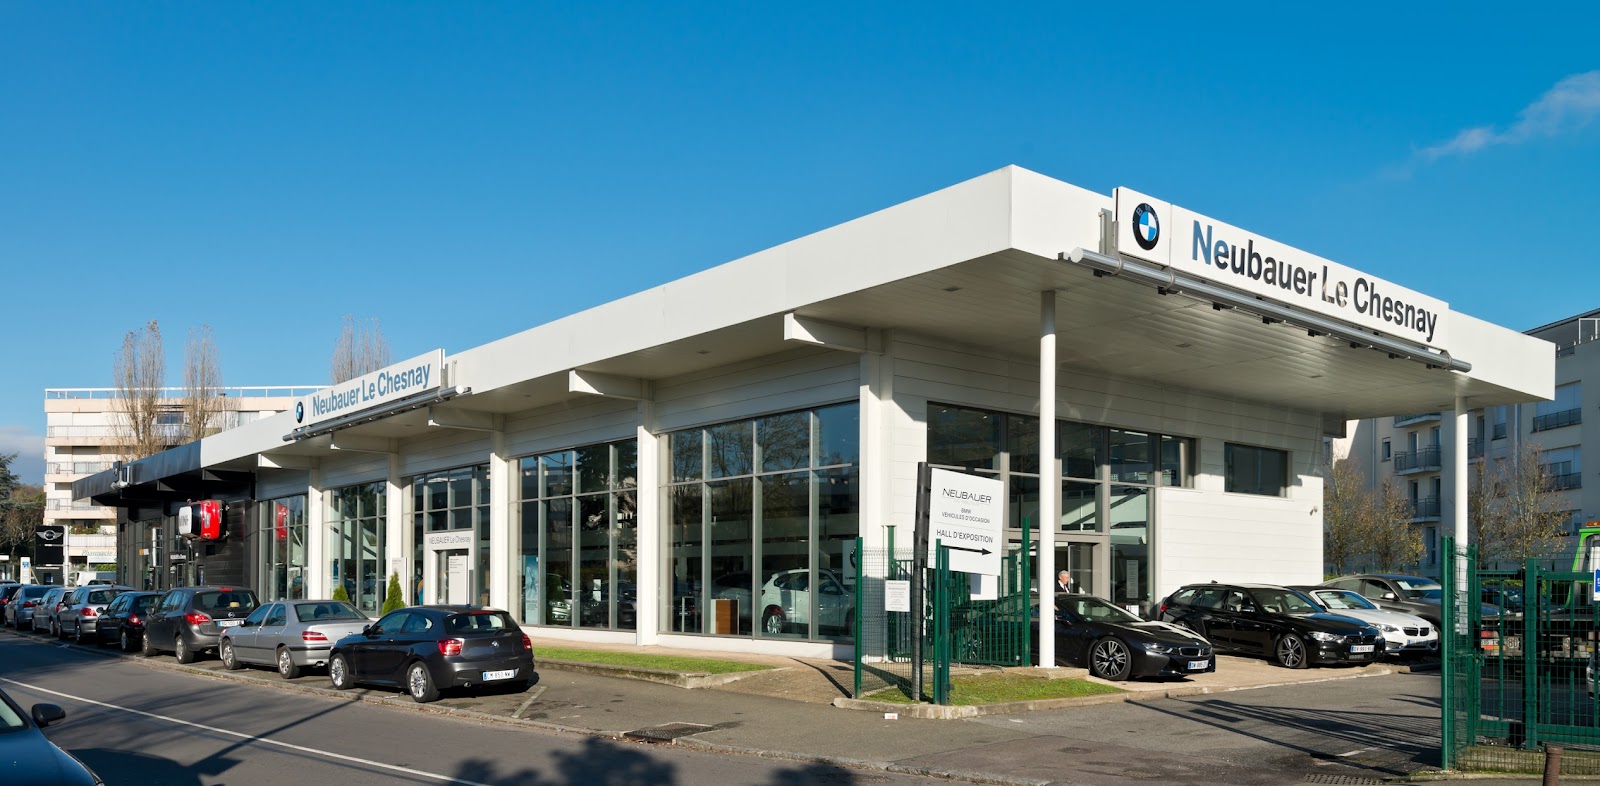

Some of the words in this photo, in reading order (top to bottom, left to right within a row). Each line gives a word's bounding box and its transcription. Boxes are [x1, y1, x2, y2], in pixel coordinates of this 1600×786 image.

[1192, 219, 1317, 297] Neubauer
[1321, 265, 1348, 308] Le
[1353, 277, 1438, 343] Chesnay
[312, 387, 360, 417] Neubauer
[362, 379, 376, 401] Le
[377, 364, 431, 397] Chesnay
[942, 488, 992, 503] NEUBAUER
[936, 529, 952, 538] HALL
[953, 532, 993, 543] D'EXPOSITION
